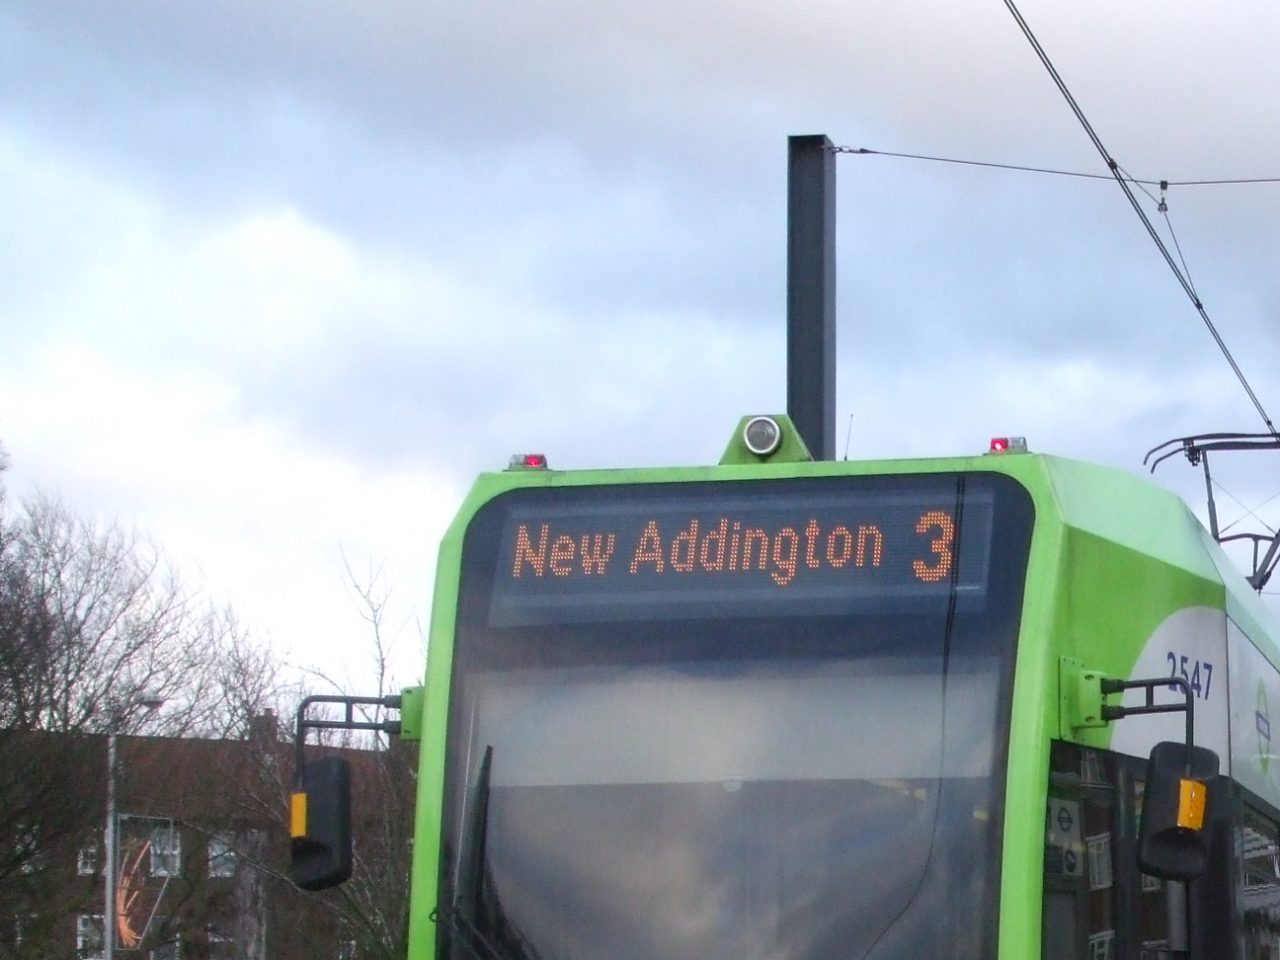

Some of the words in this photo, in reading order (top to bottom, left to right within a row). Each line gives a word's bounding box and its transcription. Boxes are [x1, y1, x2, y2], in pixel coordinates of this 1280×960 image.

[513, 524, 616, 578] New
[630, 517, 883, 586] Addington
[912, 511, 956, 582] 3
[1167, 651, 1213, 700] 2547
